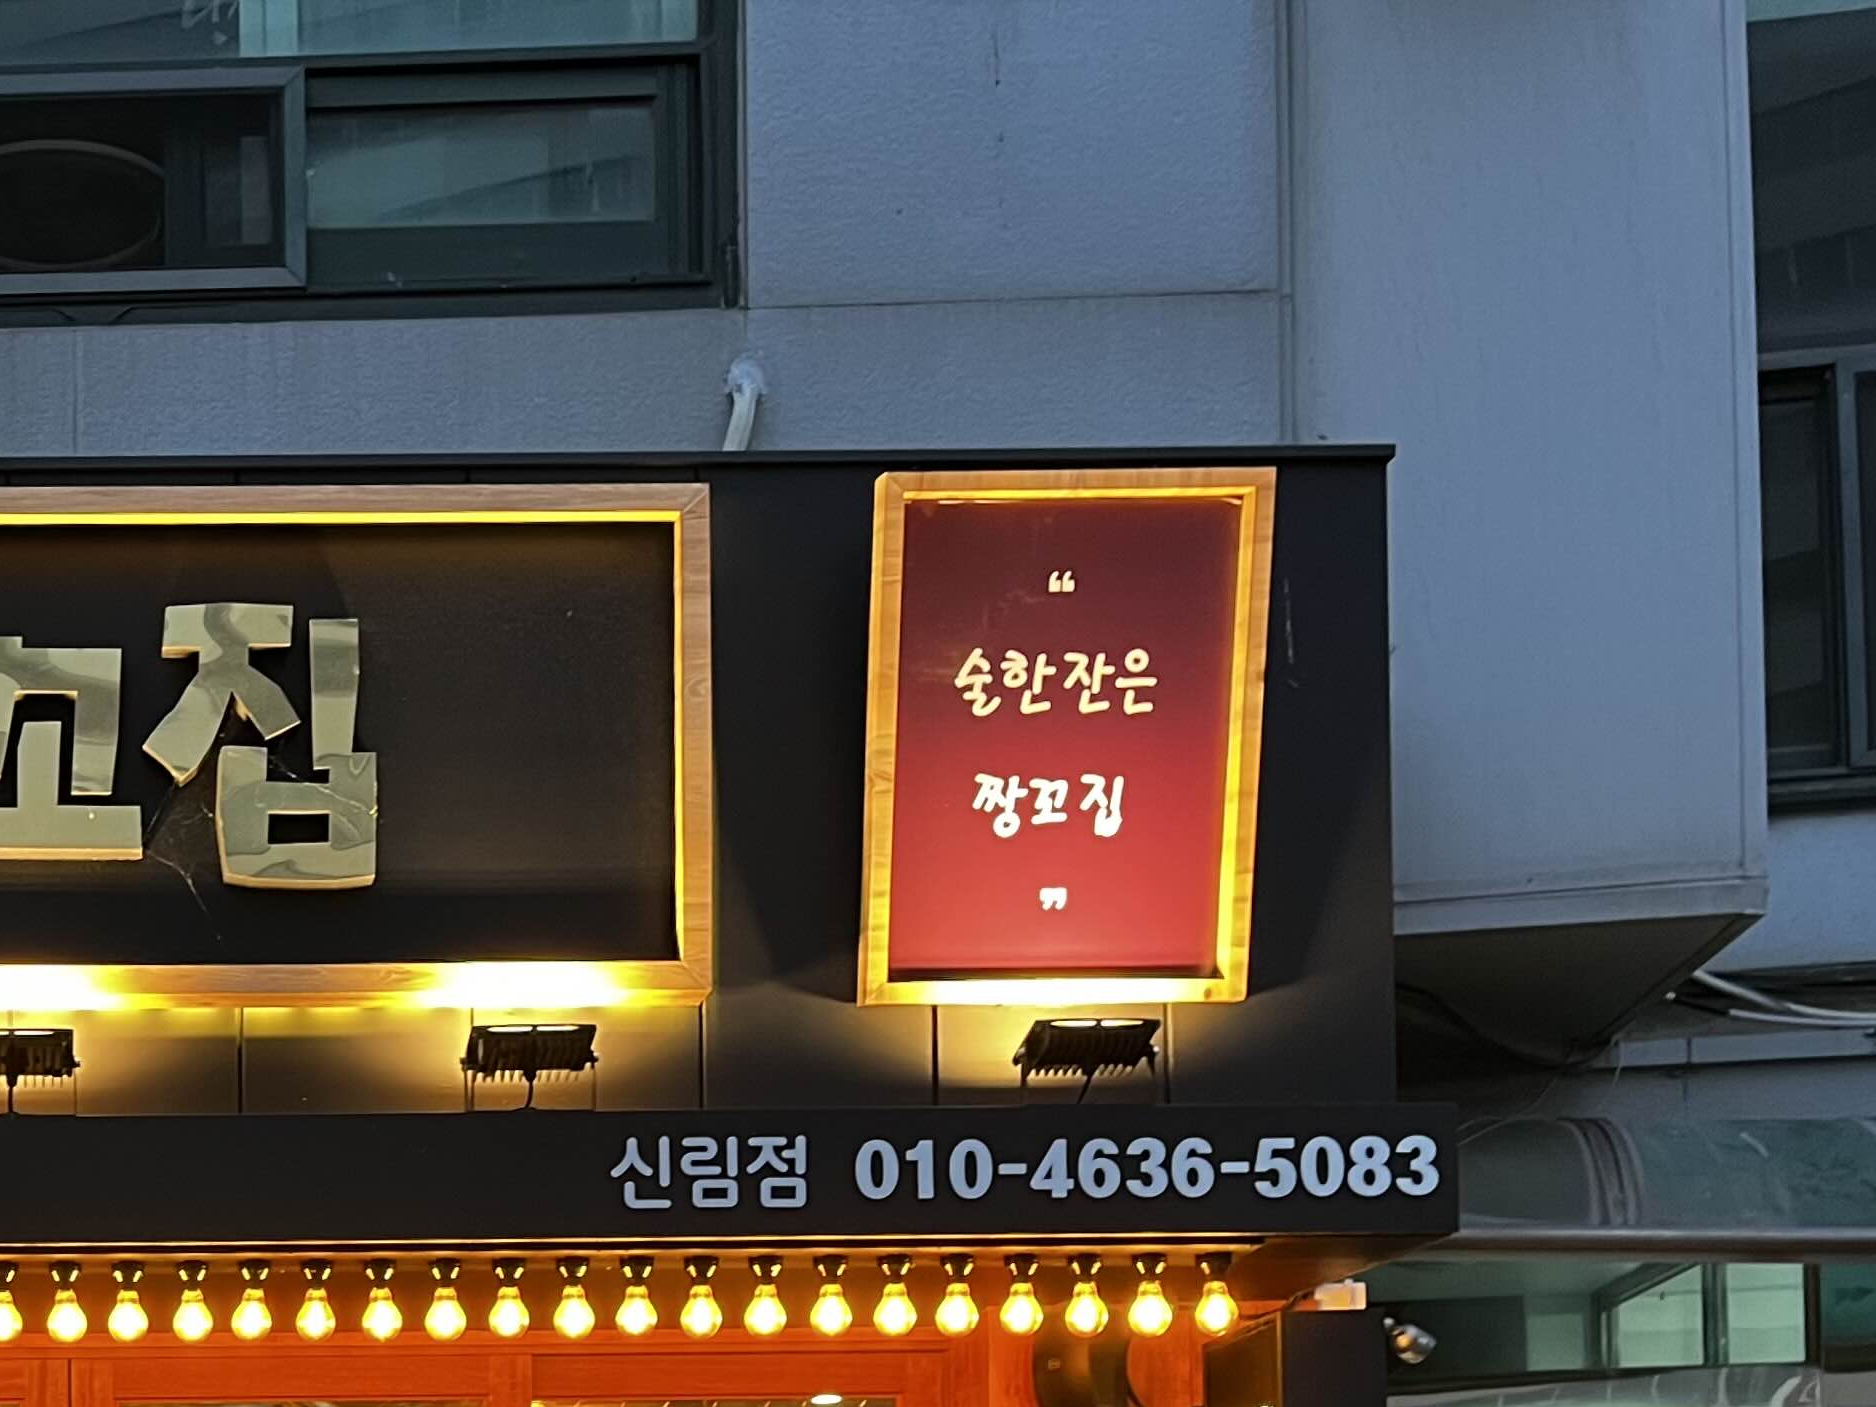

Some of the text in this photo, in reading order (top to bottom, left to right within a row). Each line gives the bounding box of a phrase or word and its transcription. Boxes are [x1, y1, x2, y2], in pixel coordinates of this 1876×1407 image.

[972, 773, 1125, 838] 짱꼬집
[609, 1134, 1441, 1210] 신림점 010-4636-5083
